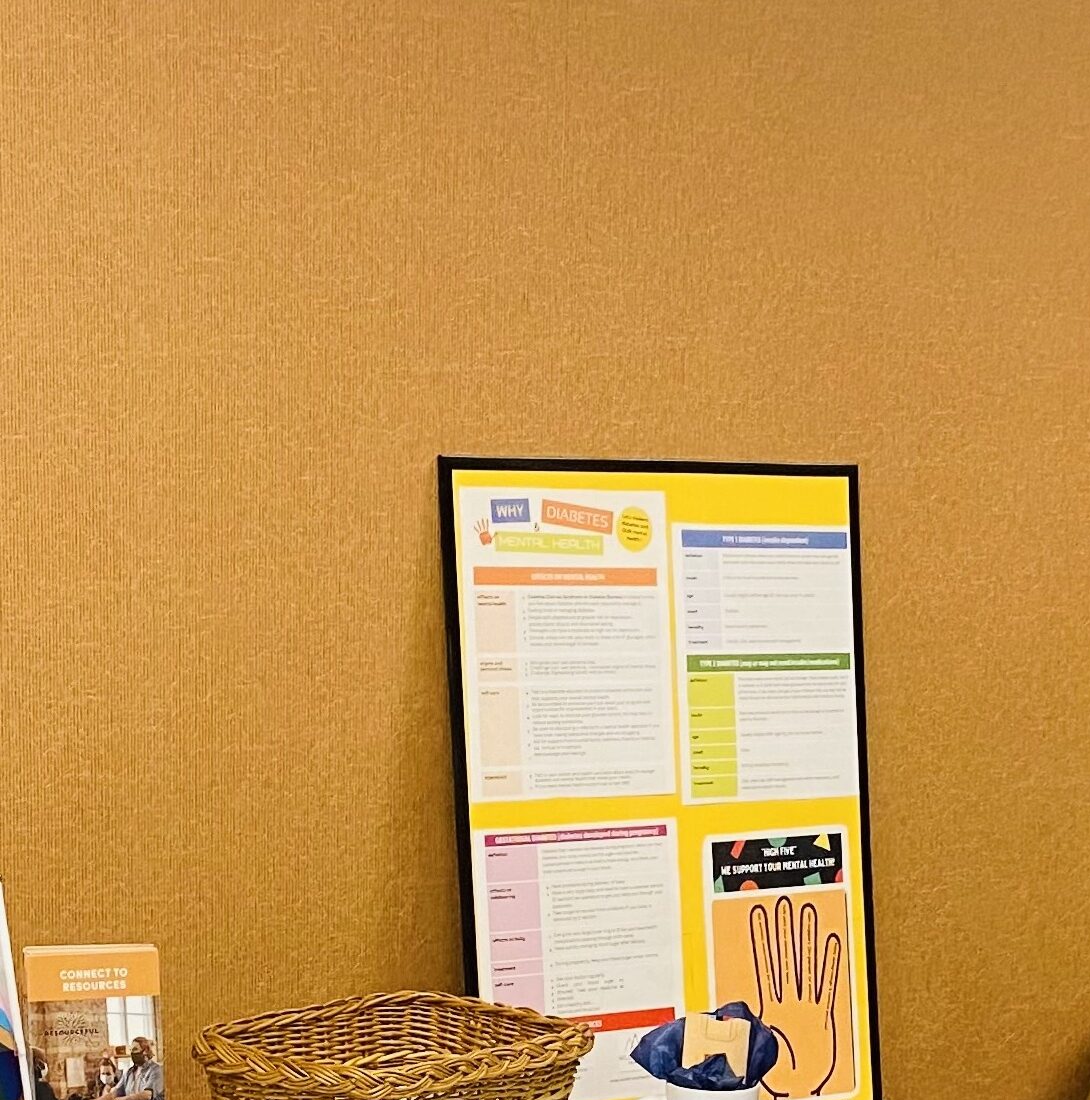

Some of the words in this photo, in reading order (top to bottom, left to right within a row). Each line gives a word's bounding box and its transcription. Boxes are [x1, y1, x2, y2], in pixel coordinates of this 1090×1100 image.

[495, 504, 524, 518] WHY
[546, 506, 609, 529] DIABETES
[500, 536, 545, 548] MENTAL
[552, 538, 600, 551] HEALTH
[732, 862, 763, 875] SUPPORT
[763, 861, 782, 872] YOUR
[782, 859, 808, 871] MENTAL
[59, 968, 111, 980] CONNECT
[113, 968, 128, 978] TO
[62, 979, 127, 992] RESOURCES
